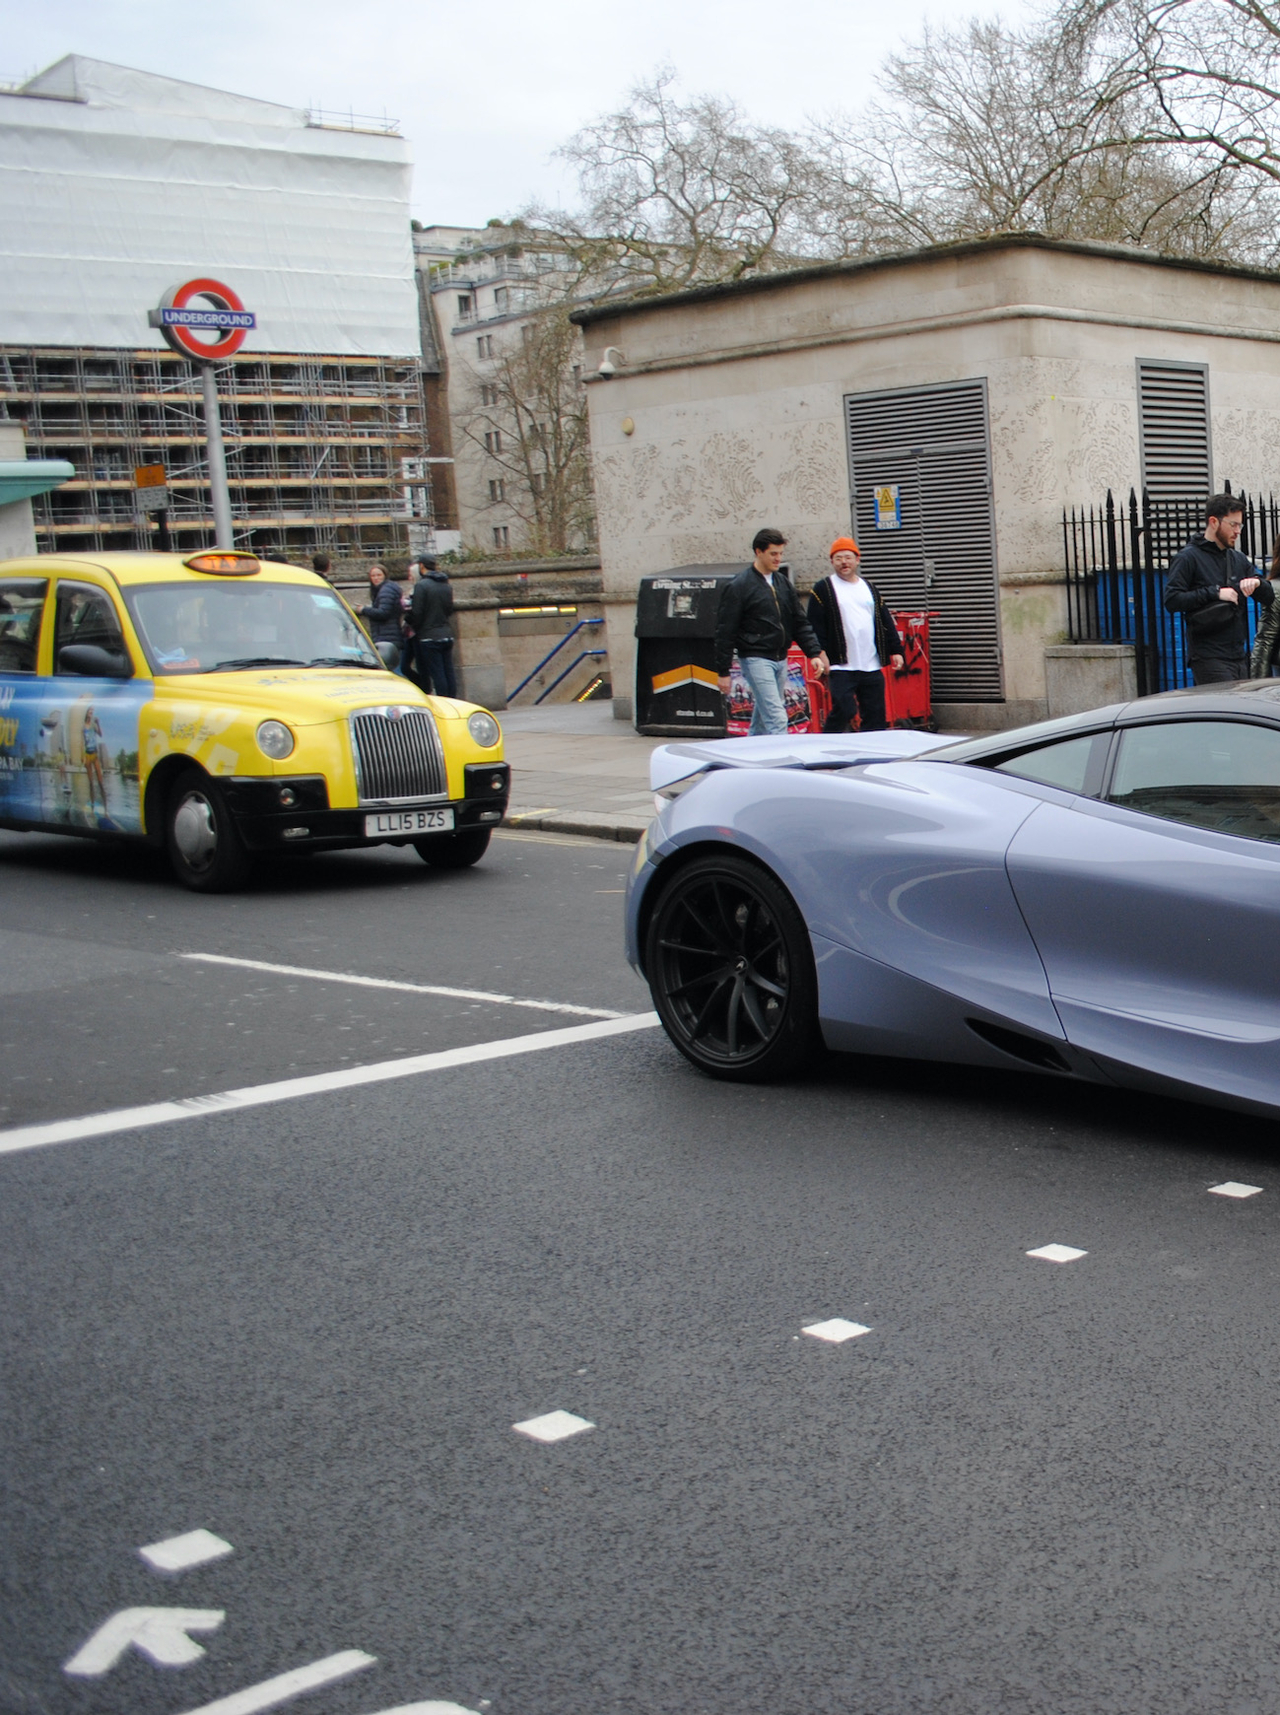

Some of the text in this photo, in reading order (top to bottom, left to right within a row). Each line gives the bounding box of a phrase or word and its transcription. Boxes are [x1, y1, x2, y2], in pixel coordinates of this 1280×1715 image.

[165, 312, 253, 326] UNDERGROUND
[682, 579, 717, 589] Stdard
[377, 811, 445, 832] LL15 BZS
